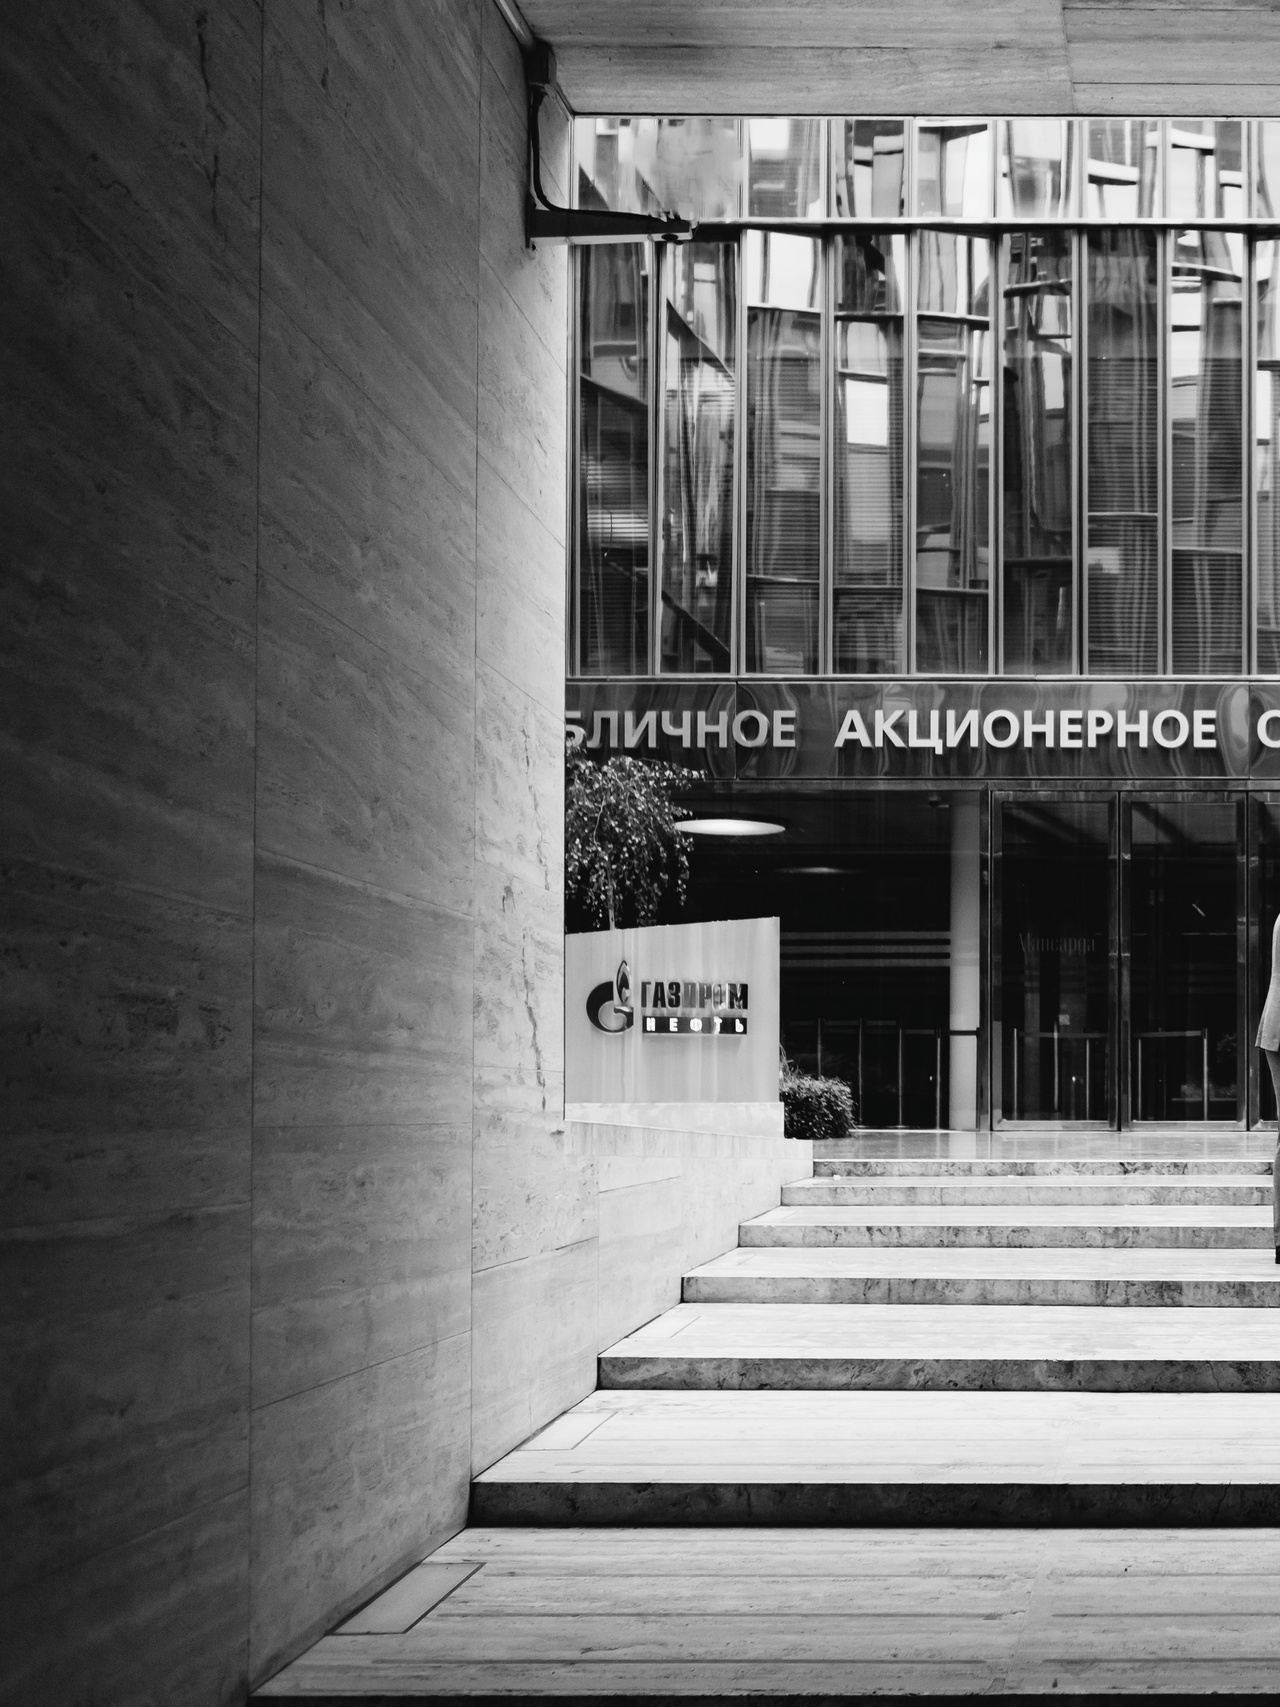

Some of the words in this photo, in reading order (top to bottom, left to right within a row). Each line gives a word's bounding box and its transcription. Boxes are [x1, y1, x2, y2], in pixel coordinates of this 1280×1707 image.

[835, 709, 1216, 755] АКЦИОНЕРНОЕ
[641, 981, 749, 1009] ГАЗПРОМ
[645, 1017, 745, 1034] НЕФТЬ
